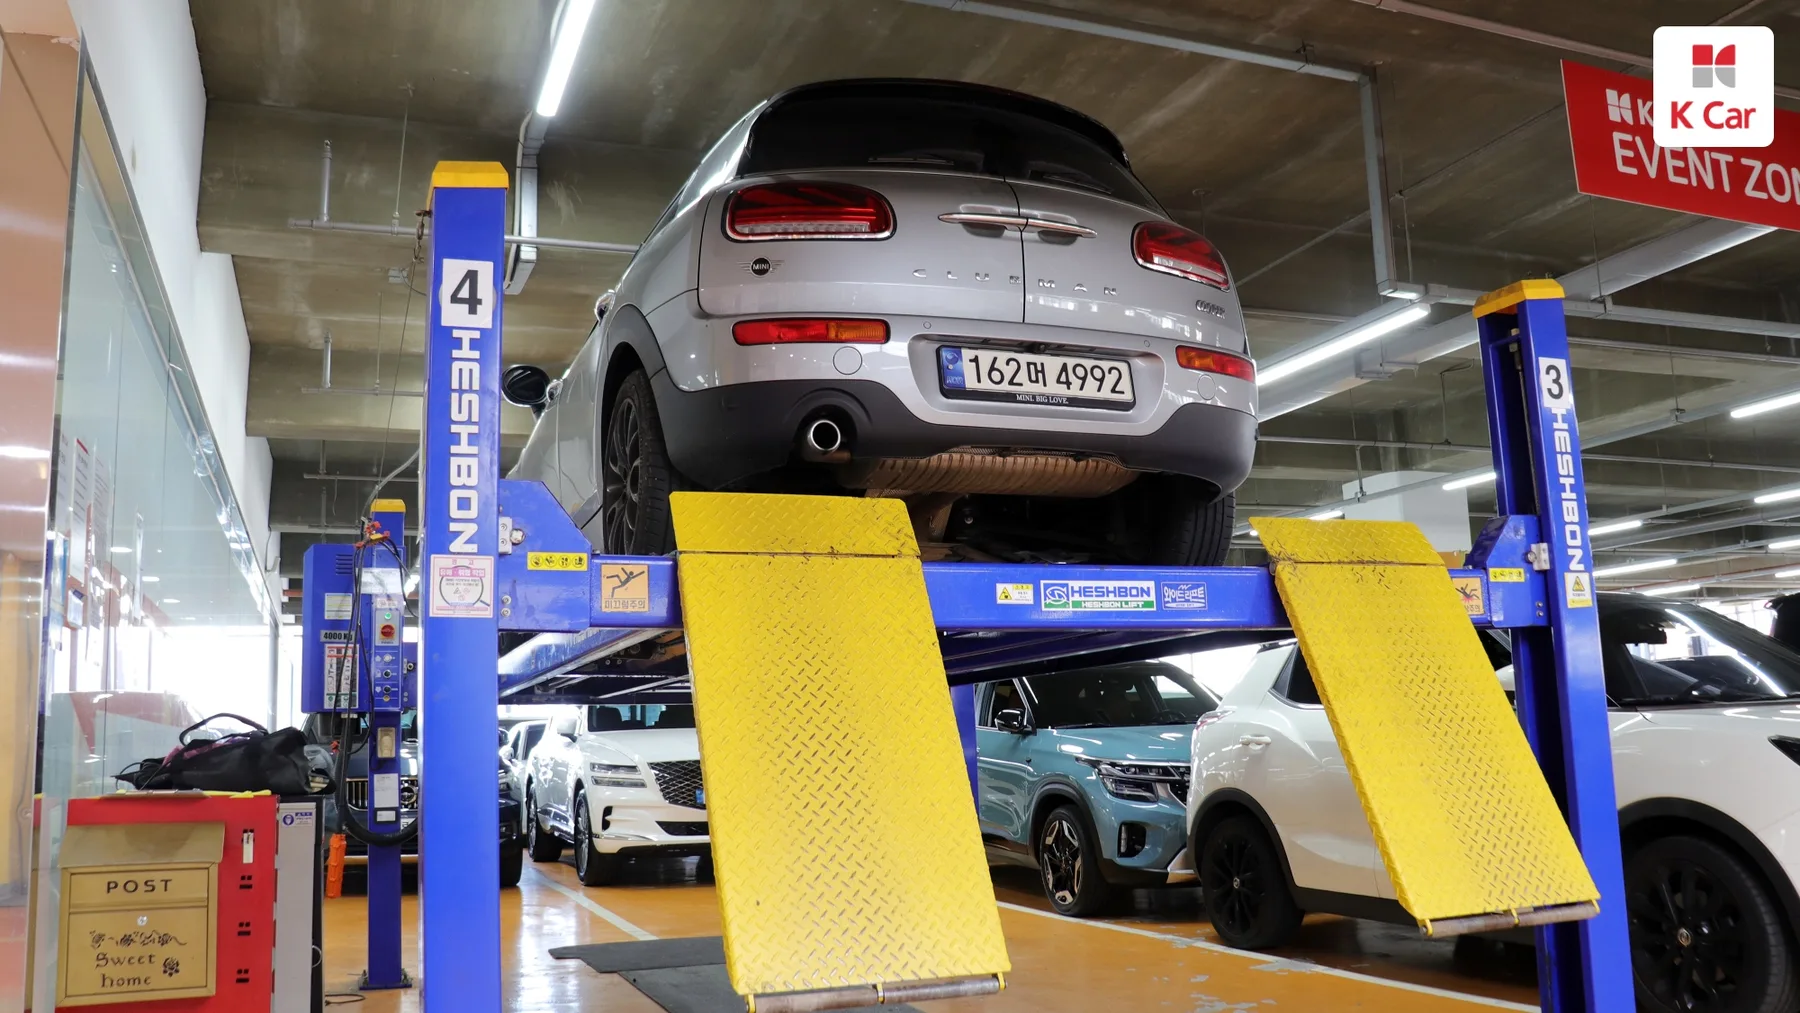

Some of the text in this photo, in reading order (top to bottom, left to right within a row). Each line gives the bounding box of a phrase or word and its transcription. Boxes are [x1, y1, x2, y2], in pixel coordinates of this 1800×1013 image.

[1613, 131, 1733, 193] EVENT
[450, 269, 482, 316] 4
[912, 268, 1118, 297] CLUBMAN
[968, 354, 1125, 395] 162머 4992
[1545, 364, 1564, 400] 3
[1036, 395, 1048, 403] BIG
[449, 329, 481, 553] HESHBON
[1551, 407, 1586, 571] HESHBON
[1070, 585, 1151, 598] HESHBON
[323, 632, 342, 640] 4000
[106, 878, 173, 894] POST
[95, 952, 156, 970] Sweet
[100, 973, 152, 989] home
